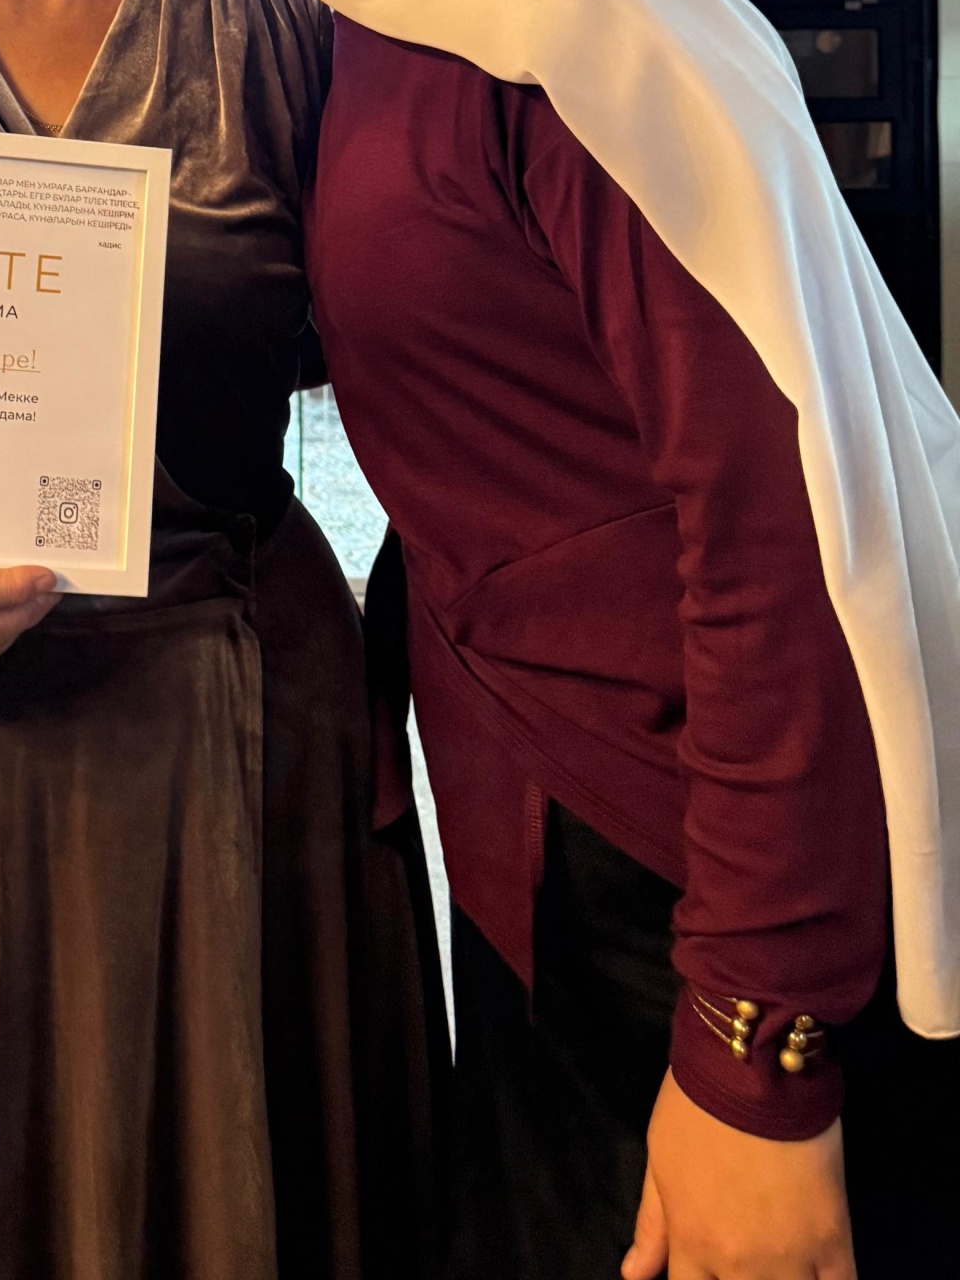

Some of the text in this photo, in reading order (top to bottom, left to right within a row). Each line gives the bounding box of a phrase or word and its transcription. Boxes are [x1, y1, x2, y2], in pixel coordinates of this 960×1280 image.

[16, 180, 36, 189] МЕН
[37, 181, 74, 192] УМРАҒА
[30, 191, 51, 200] ЕГЕР
[53, 193, 82, 202] БҰЛАР
[83, 196, 108, 206] ТІЛЕК
[97, 209, 135, 219] КЕШІРІМ
[97, 241, 122, 250] хадис
